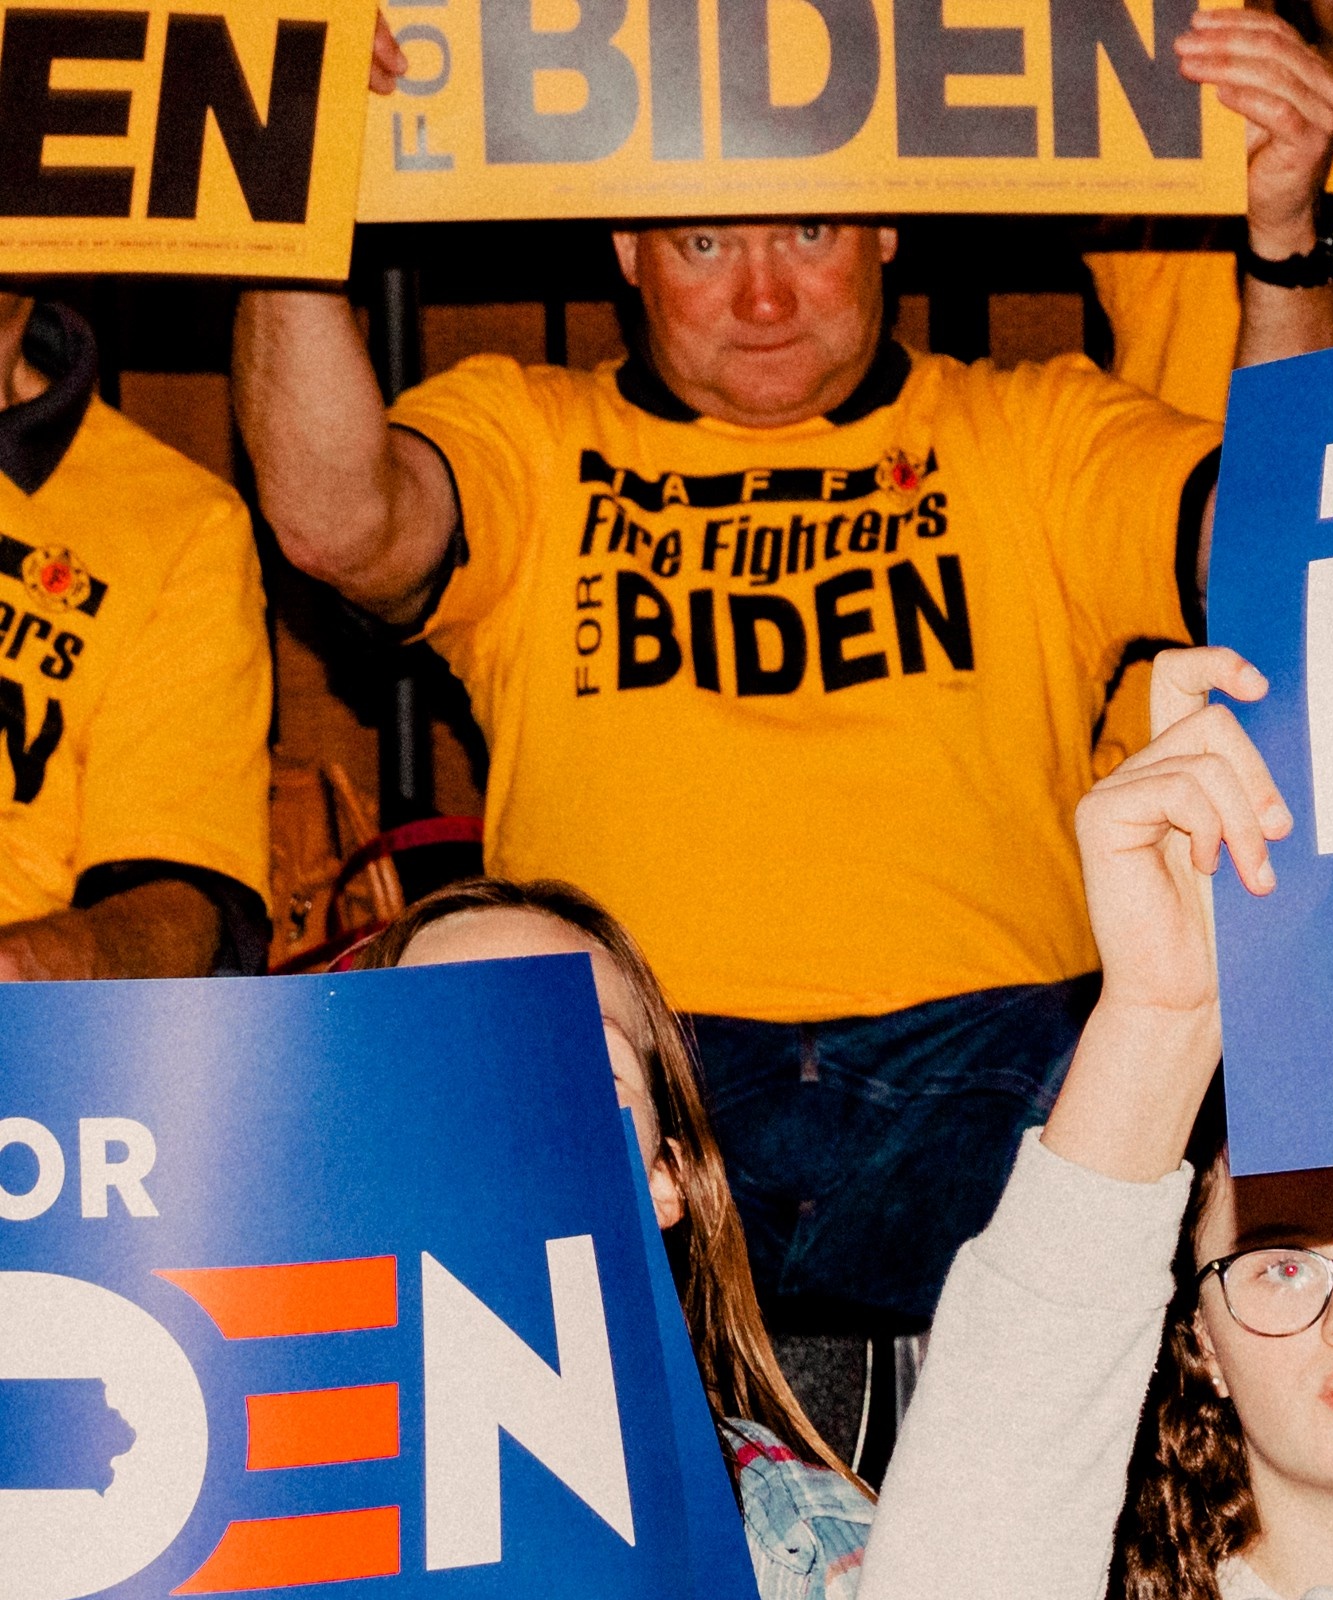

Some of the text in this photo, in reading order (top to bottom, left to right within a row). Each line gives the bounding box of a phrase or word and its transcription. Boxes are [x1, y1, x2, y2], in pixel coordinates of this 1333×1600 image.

[390, 0, 454, 172] FO
[479, 0, 1203, 166] BIDEN
[579, 492, 948, 586] Fire Fighters
[575, 573, 603, 698] FOR
[617, 554, 975, 697] BIDEN
